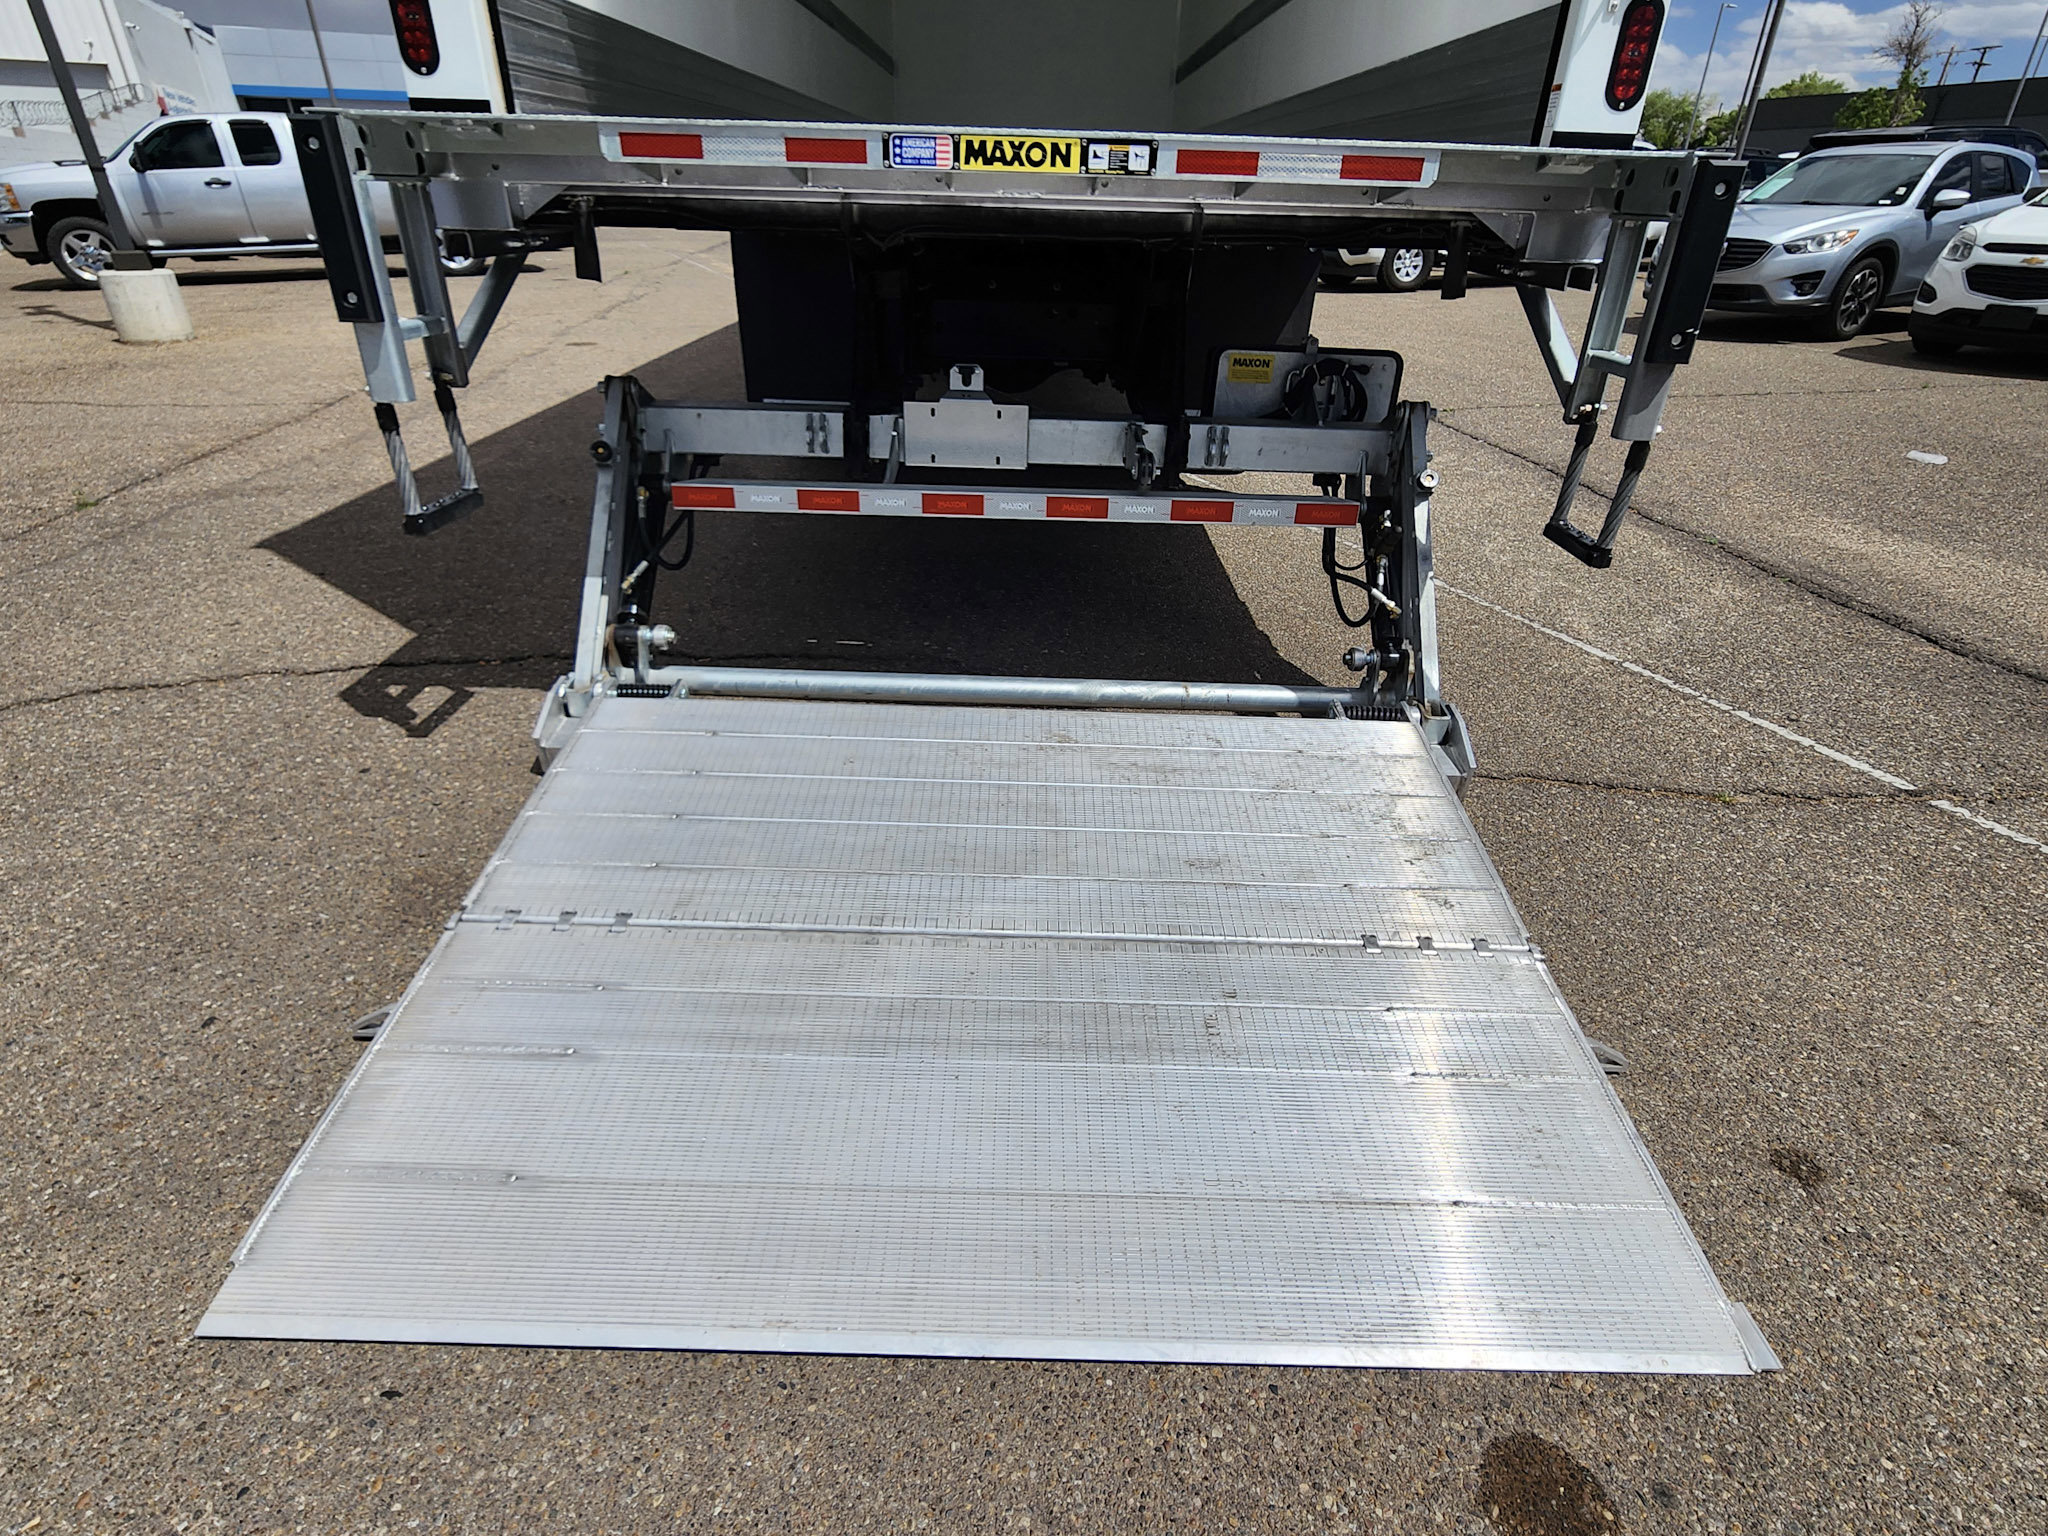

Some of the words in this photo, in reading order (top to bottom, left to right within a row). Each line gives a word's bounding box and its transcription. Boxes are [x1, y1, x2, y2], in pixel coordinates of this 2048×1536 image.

[902, 137, 935, 147] AMERICAN
[902, 147, 935, 158] COMPANY
[964, 140, 1072, 168] MAXON
[1233, 357, 1270, 369] MAXON
[752, 495, 781, 504] MAXON
[876, 498, 905, 507] MAXON
[1000, 502, 1030, 511] MAXON
[1063, 504, 1092, 513] MAXON
[1125, 505, 1154, 514] MAXON
[1187, 507, 1216, 516] MAXON
[1249, 509, 1279, 518] MAXON
